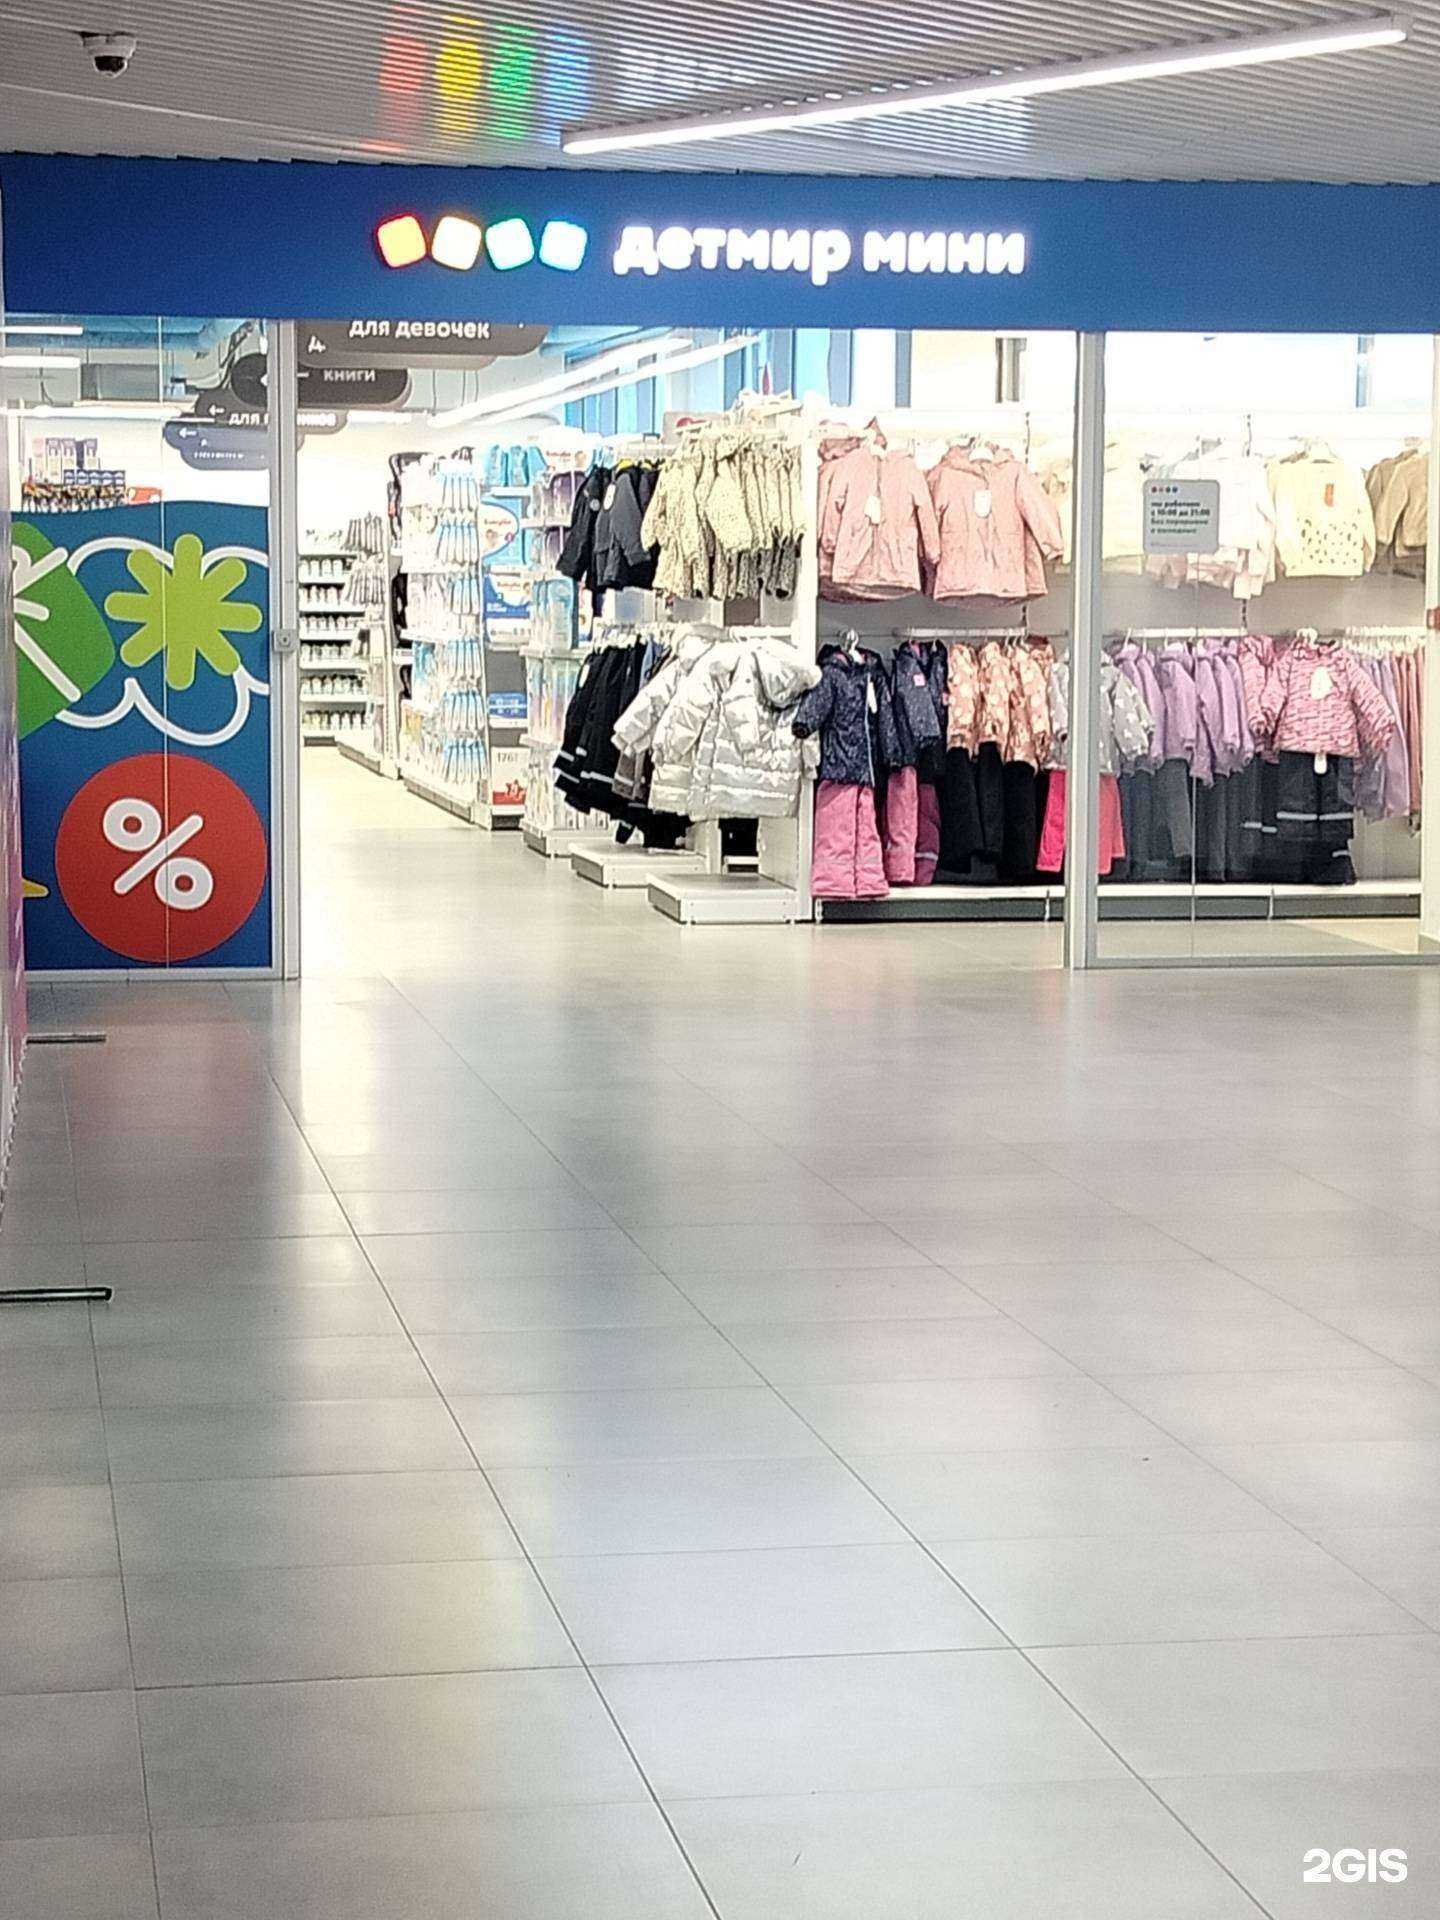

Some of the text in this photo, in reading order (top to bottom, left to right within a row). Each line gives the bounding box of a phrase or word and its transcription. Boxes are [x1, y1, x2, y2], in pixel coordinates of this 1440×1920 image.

[612, 225, 1026, 286] детмир мини
[349, 320, 490, 340] для девочек
[323, 370, 376, 382] книги
[228, 413, 260, 427] для
